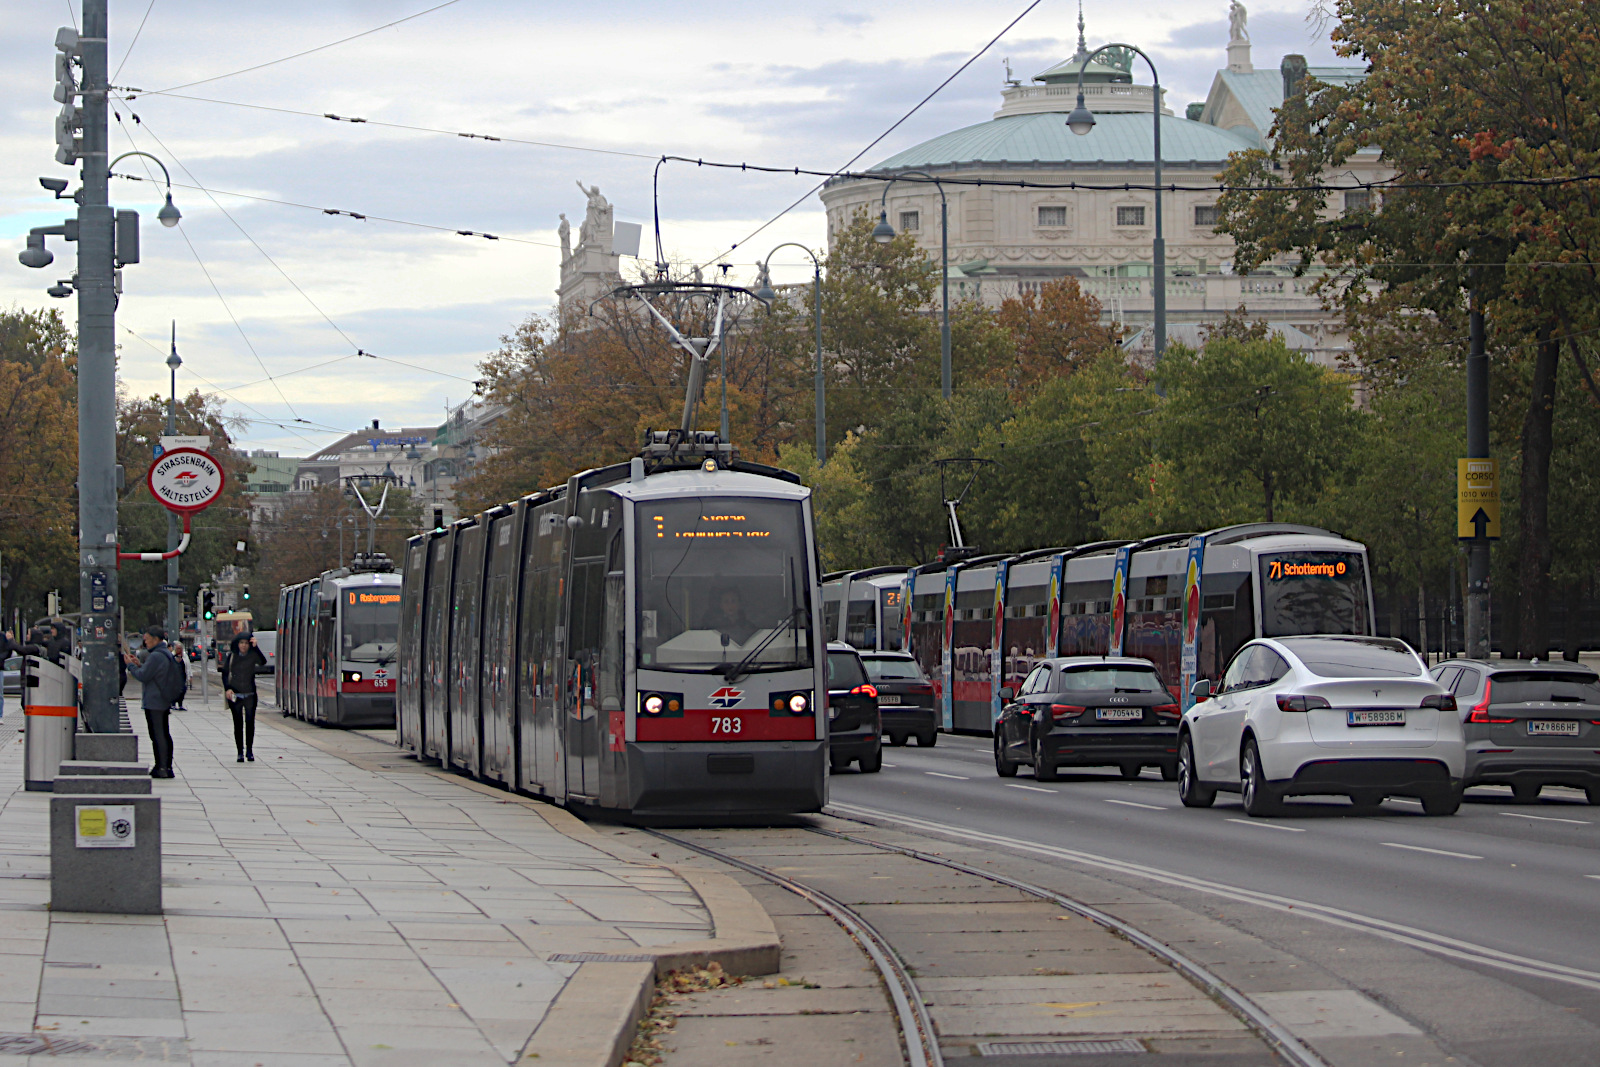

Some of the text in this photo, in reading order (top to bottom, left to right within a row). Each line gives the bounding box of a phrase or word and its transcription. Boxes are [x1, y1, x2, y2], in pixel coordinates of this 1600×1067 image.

[157, 456, 216, 476] STRASSENBAHN
[1465, 472, 1495, 480] CORSO
[159, 485, 213, 502] HALTESTELLE
[1269, 561, 1282, 579] 71
[1284, 562, 1335, 577] Schottenring
[349, 592, 356, 605] D
[374, 679, 388, 687] 655
[711, 717, 741, 733] 783
